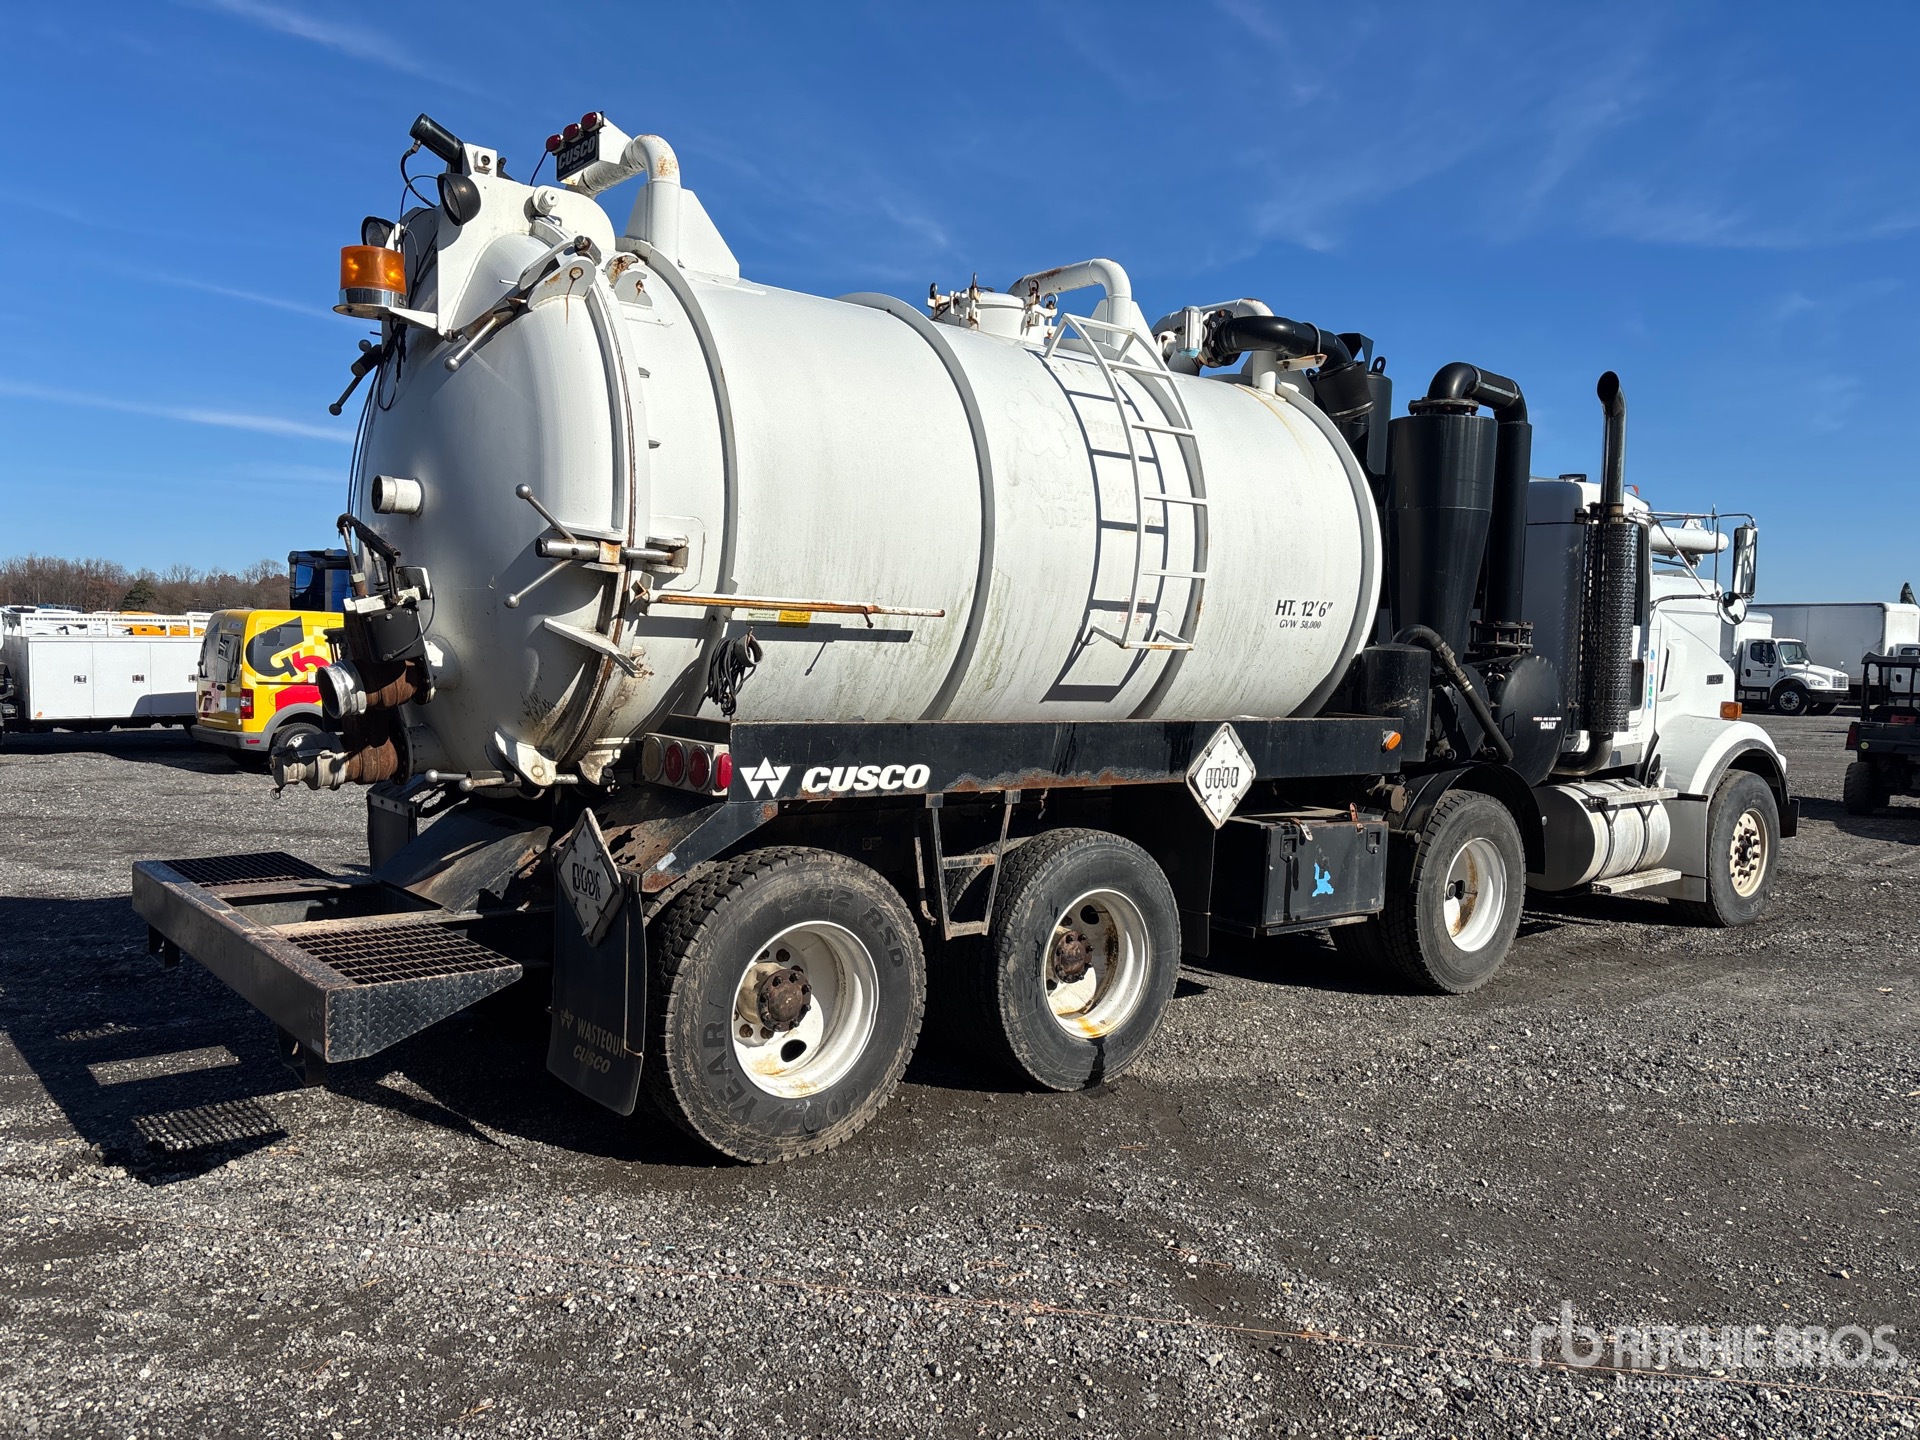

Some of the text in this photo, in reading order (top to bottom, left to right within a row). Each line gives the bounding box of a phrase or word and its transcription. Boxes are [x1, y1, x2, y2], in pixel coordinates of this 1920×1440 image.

[558, 136, 595, 169] CUSCO
[1275, 600, 1296, 616] HT.
[1280, 619, 1298, 628] GVW
[1540, 721, 1557, 730] DAILY
[801, 764, 931, 793] CUSCO
[861, 906, 905, 969] RSD
[573, 1044, 612, 1074] CUSCO
